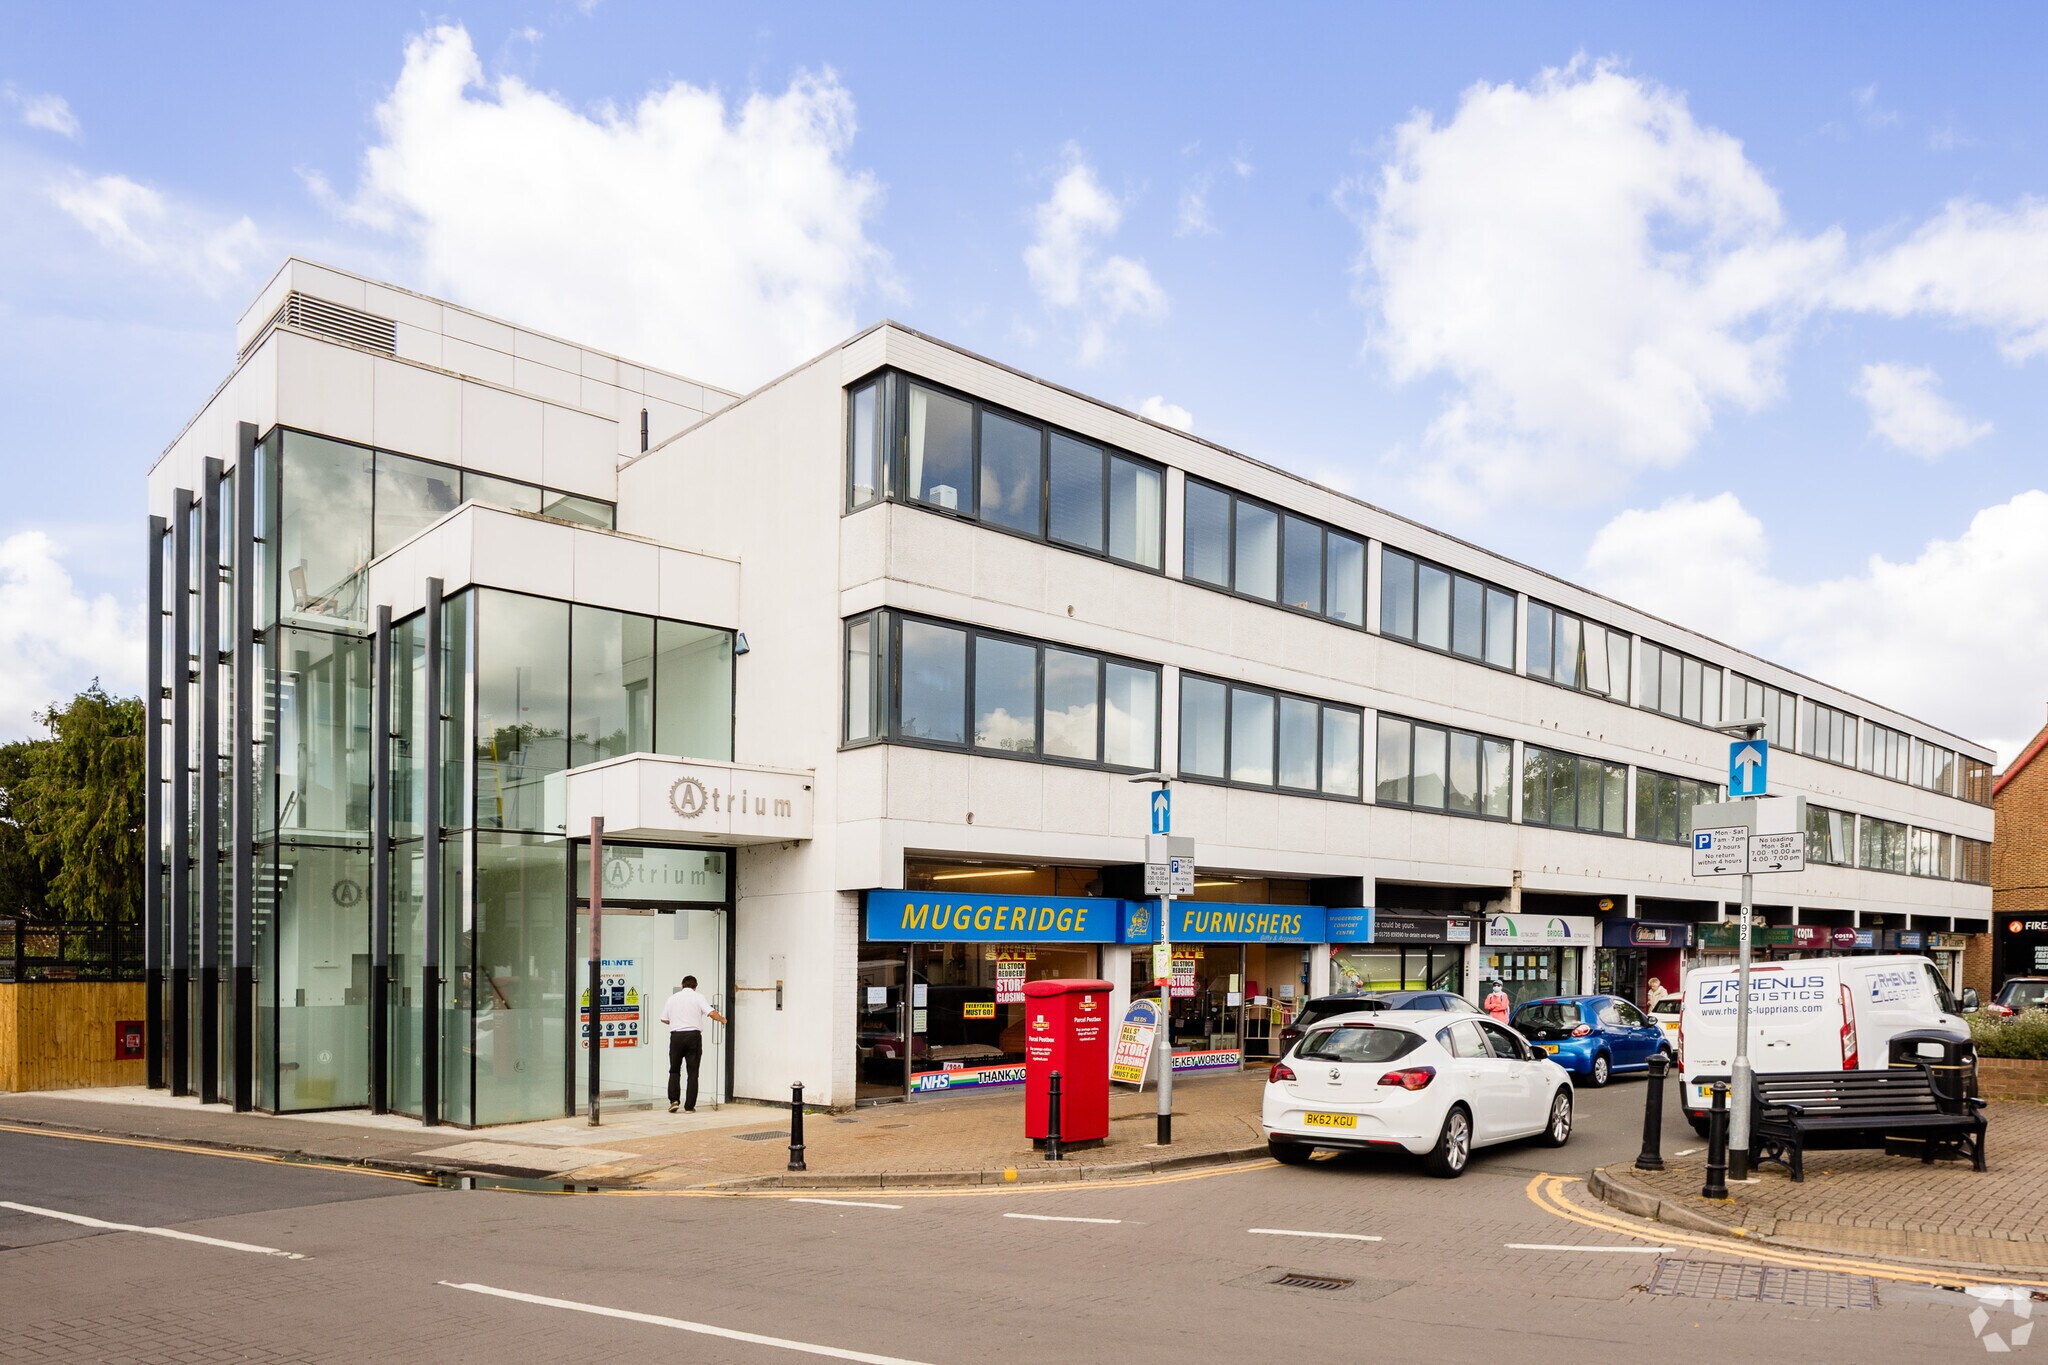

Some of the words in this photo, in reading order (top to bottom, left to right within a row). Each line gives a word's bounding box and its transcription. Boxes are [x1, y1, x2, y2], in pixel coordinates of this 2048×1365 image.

[680, 783, 791, 817] Atrium
[611, 860, 706, 885] Atrium
[901, 903, 1088, 932] MUGGERIDGE
[1183, 911, 1302, 935] FURNISHERS
[1741, 907, 1749, 940] 0192
[2025, 921, 2048, 930] FIRE
[1490, 928, 1508, 936] BRIDGE
[1547, 929, 1563, 937] BRIDGE
[1797, 928, 1813, 939] COSTA
[985, 944, 1037, 953] RETIREMENT
[985, 952, 1037, 960] SALE
[1172, 951, 1205, 959] ALE
[997, 979, 1026, 992] STORE
[1172, 975, 1195, 986] STORE
[996, 992, 1026, 1002] CLOSING
[1171, 987, 1194, 996] CLOSING
[1702, 1005, 1822, 1016] www.rhes-lupprians.com
[1118, 1042, 1149, 1057] STORE
[1115, 1054, 1145, 1067] CLOSING
[1181, 1056, 1196, 1066] KEY
[1197, 1054, 1237, 1065] WORKERS!
[1114, 1065, 1142, 1073] EVERYTHING
[978, 1069, 1012, 1083] THANK
[1014, 1069, 1026, 1079] YO
[921, 1074, 949, 1090] NHS
[1306, 1114, 1331, 1125] BK62
[1333, 1116, 1354, 1127] KGU
